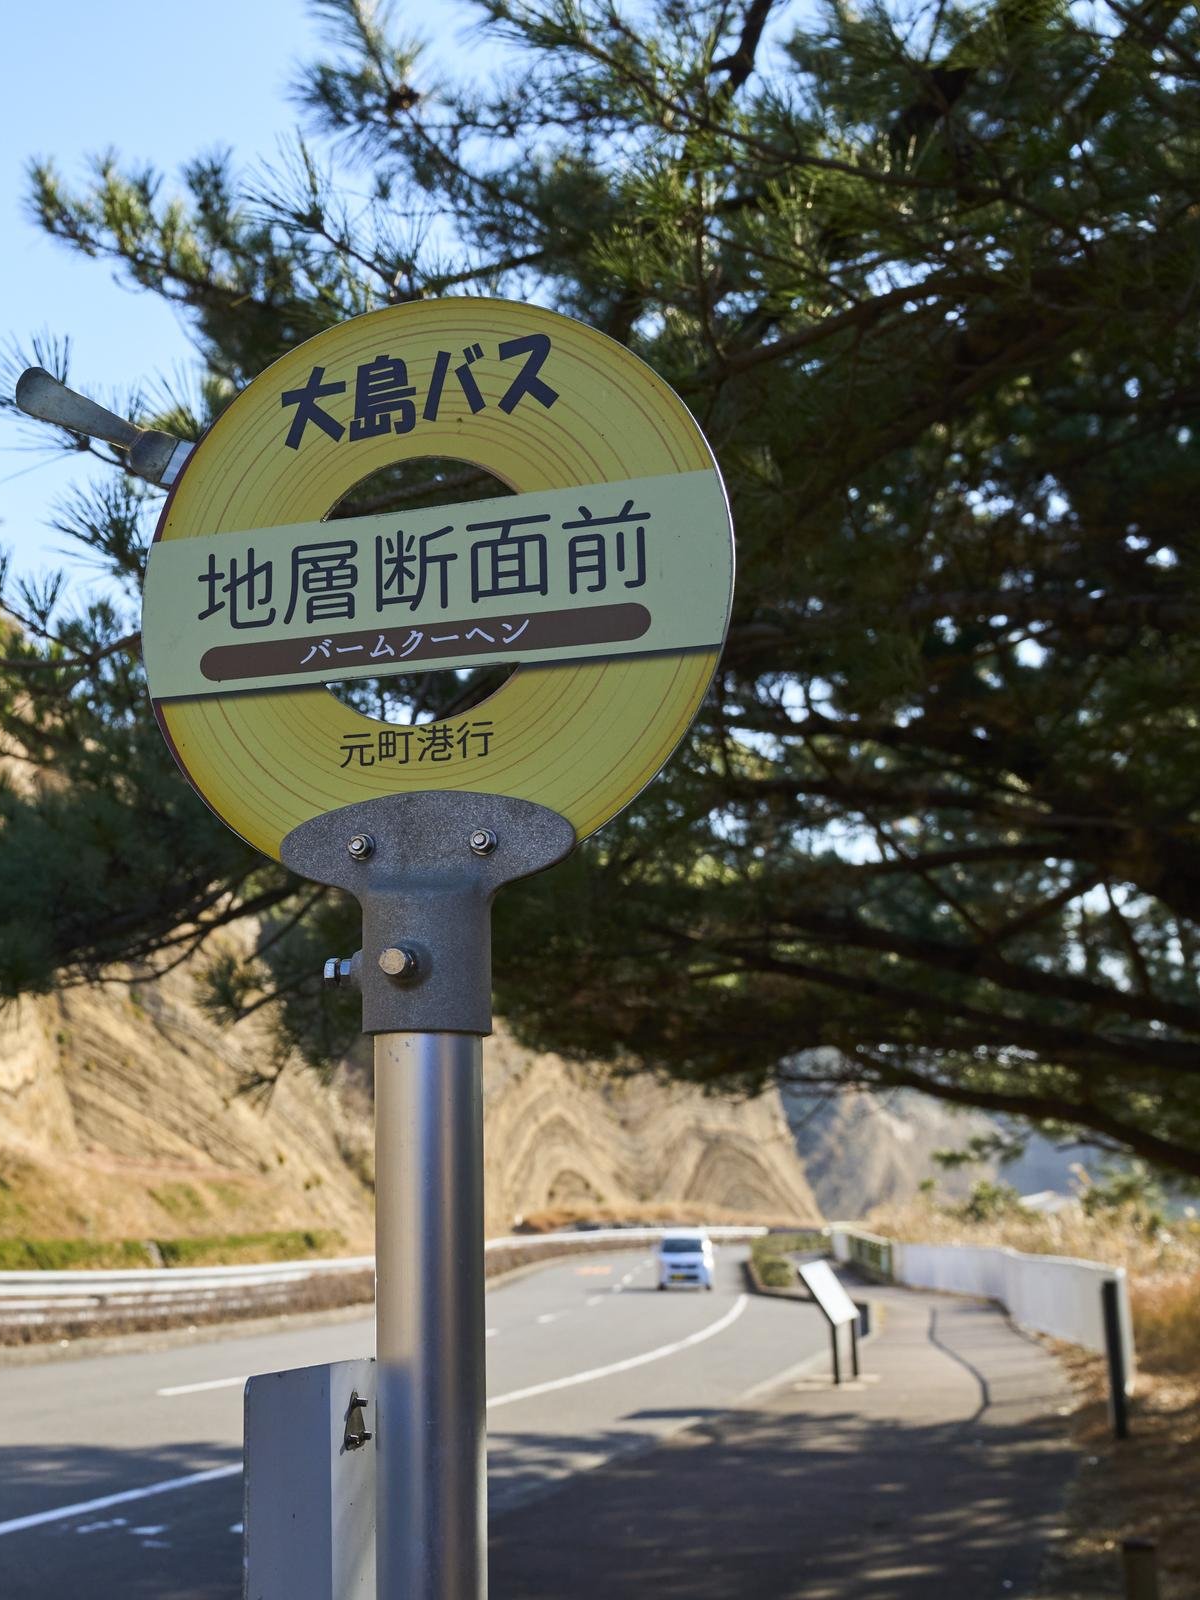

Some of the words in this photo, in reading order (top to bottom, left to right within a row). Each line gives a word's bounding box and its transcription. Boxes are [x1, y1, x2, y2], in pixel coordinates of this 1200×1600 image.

[281, 333, 560, 451] 大島バス
[197, 499, 652, 630] 地層断面前
[300, 618, 530, 665] バームクーヘン
[340, 721, 494, 769] 元町港行
